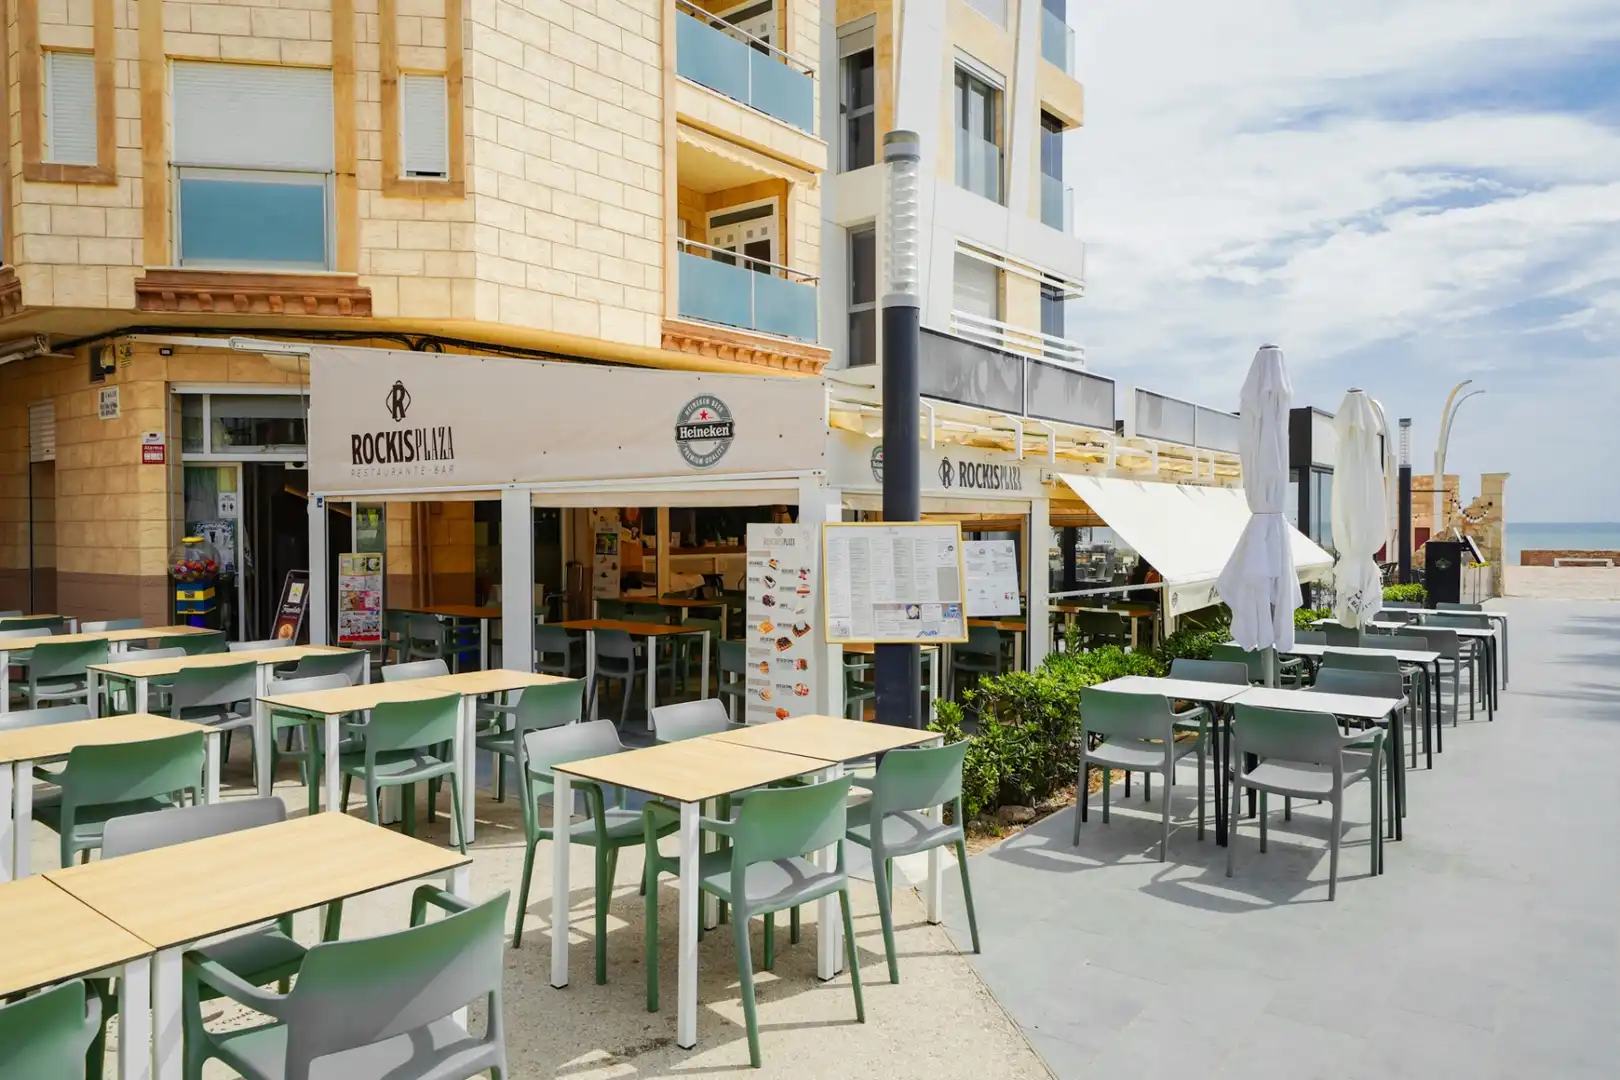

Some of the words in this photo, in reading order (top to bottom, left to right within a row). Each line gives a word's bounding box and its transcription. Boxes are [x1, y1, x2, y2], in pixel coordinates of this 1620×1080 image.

[684, 398, 710, 416] HEINEKEN
[711, 400, 724, 413] BEER
[679, 424, 730, 439] Heineken
